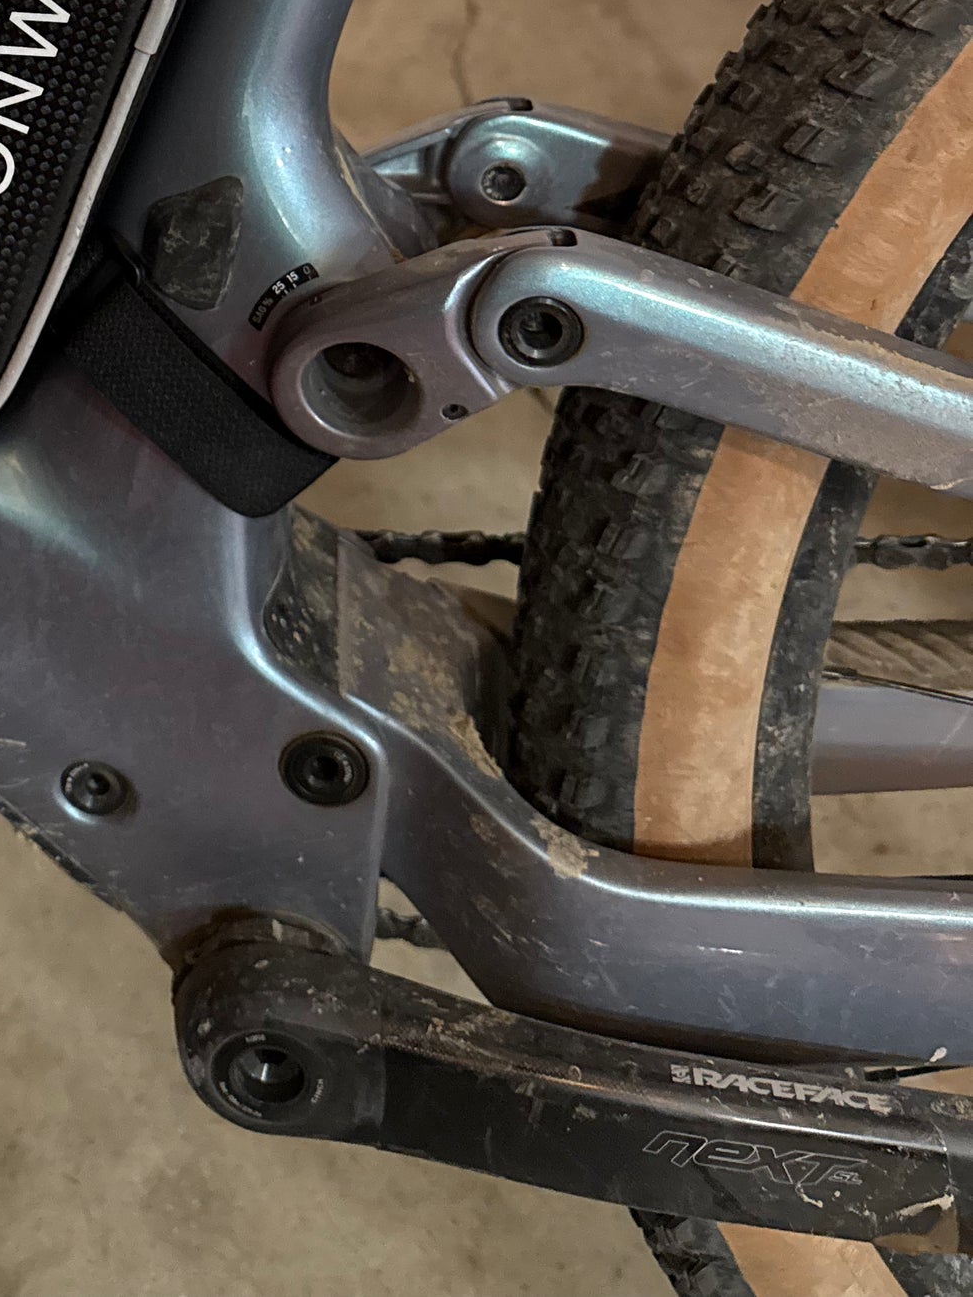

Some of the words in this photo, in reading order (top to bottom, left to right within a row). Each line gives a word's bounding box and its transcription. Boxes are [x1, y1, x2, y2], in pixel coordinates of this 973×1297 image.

[272, 280, 286, 295] 25
[286, 271, 299, 283] 15
[692, 1067, 893, 1116] RACEFACE
